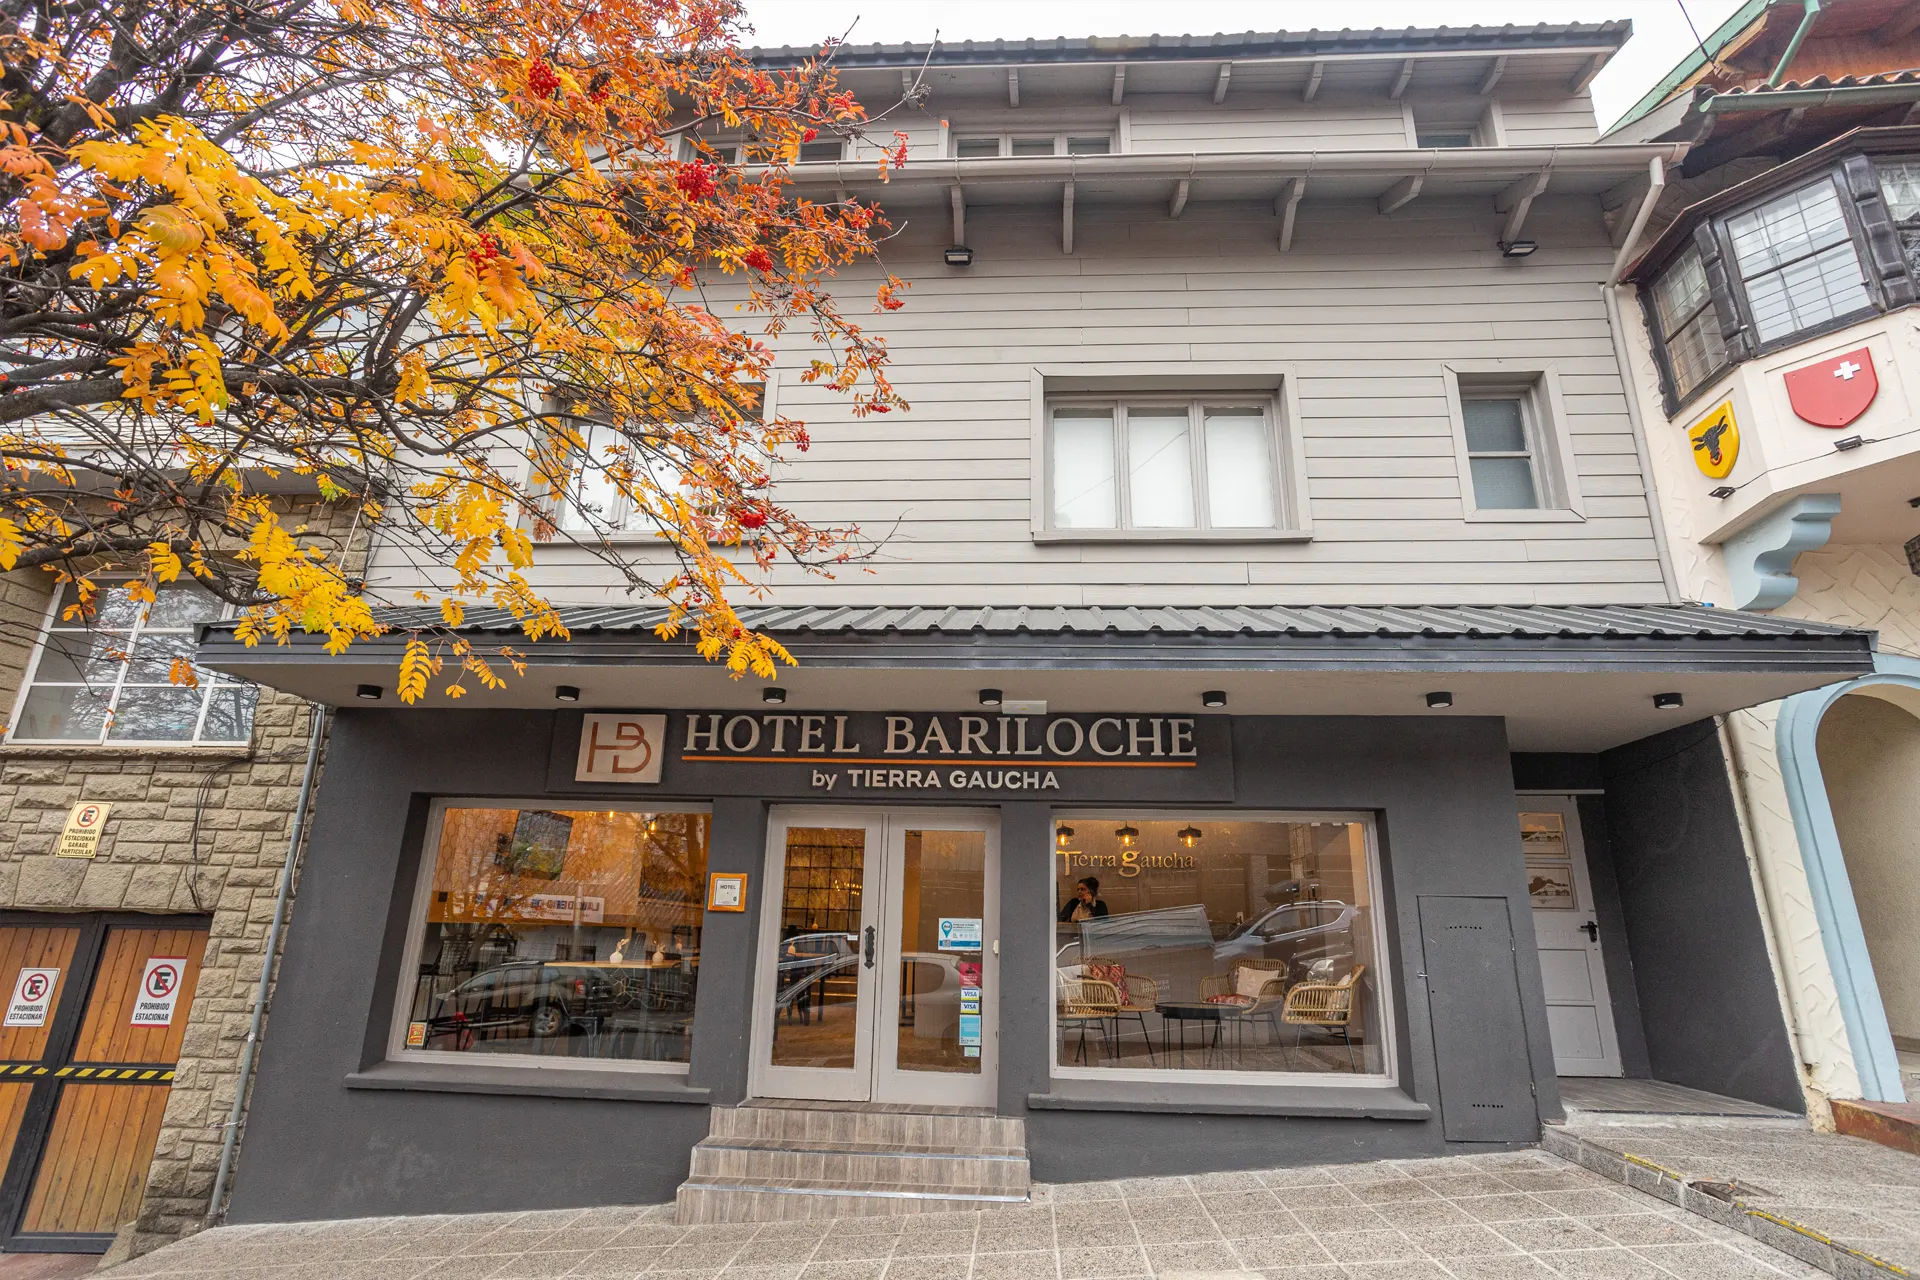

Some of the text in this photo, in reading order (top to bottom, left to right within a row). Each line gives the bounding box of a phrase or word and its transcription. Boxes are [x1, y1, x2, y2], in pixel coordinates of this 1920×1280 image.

[683, 714, 1197, 757] HOTEL BARILOCHE
[811, 769, 1060, 791] by TIERRA GAUCHA
[64, 834, 96, 842] ESTACIONAR
[1056, 850, 1118, 876] Tierra
[13, 1004, 43, 1012] PROHIBIDO
[139, 1002, 170, 1010] PROHIBIDO
[9, 1012, 43, 1020] ESTACIONAR
[134, 1012, 169, 1021] ESTACIONAR
